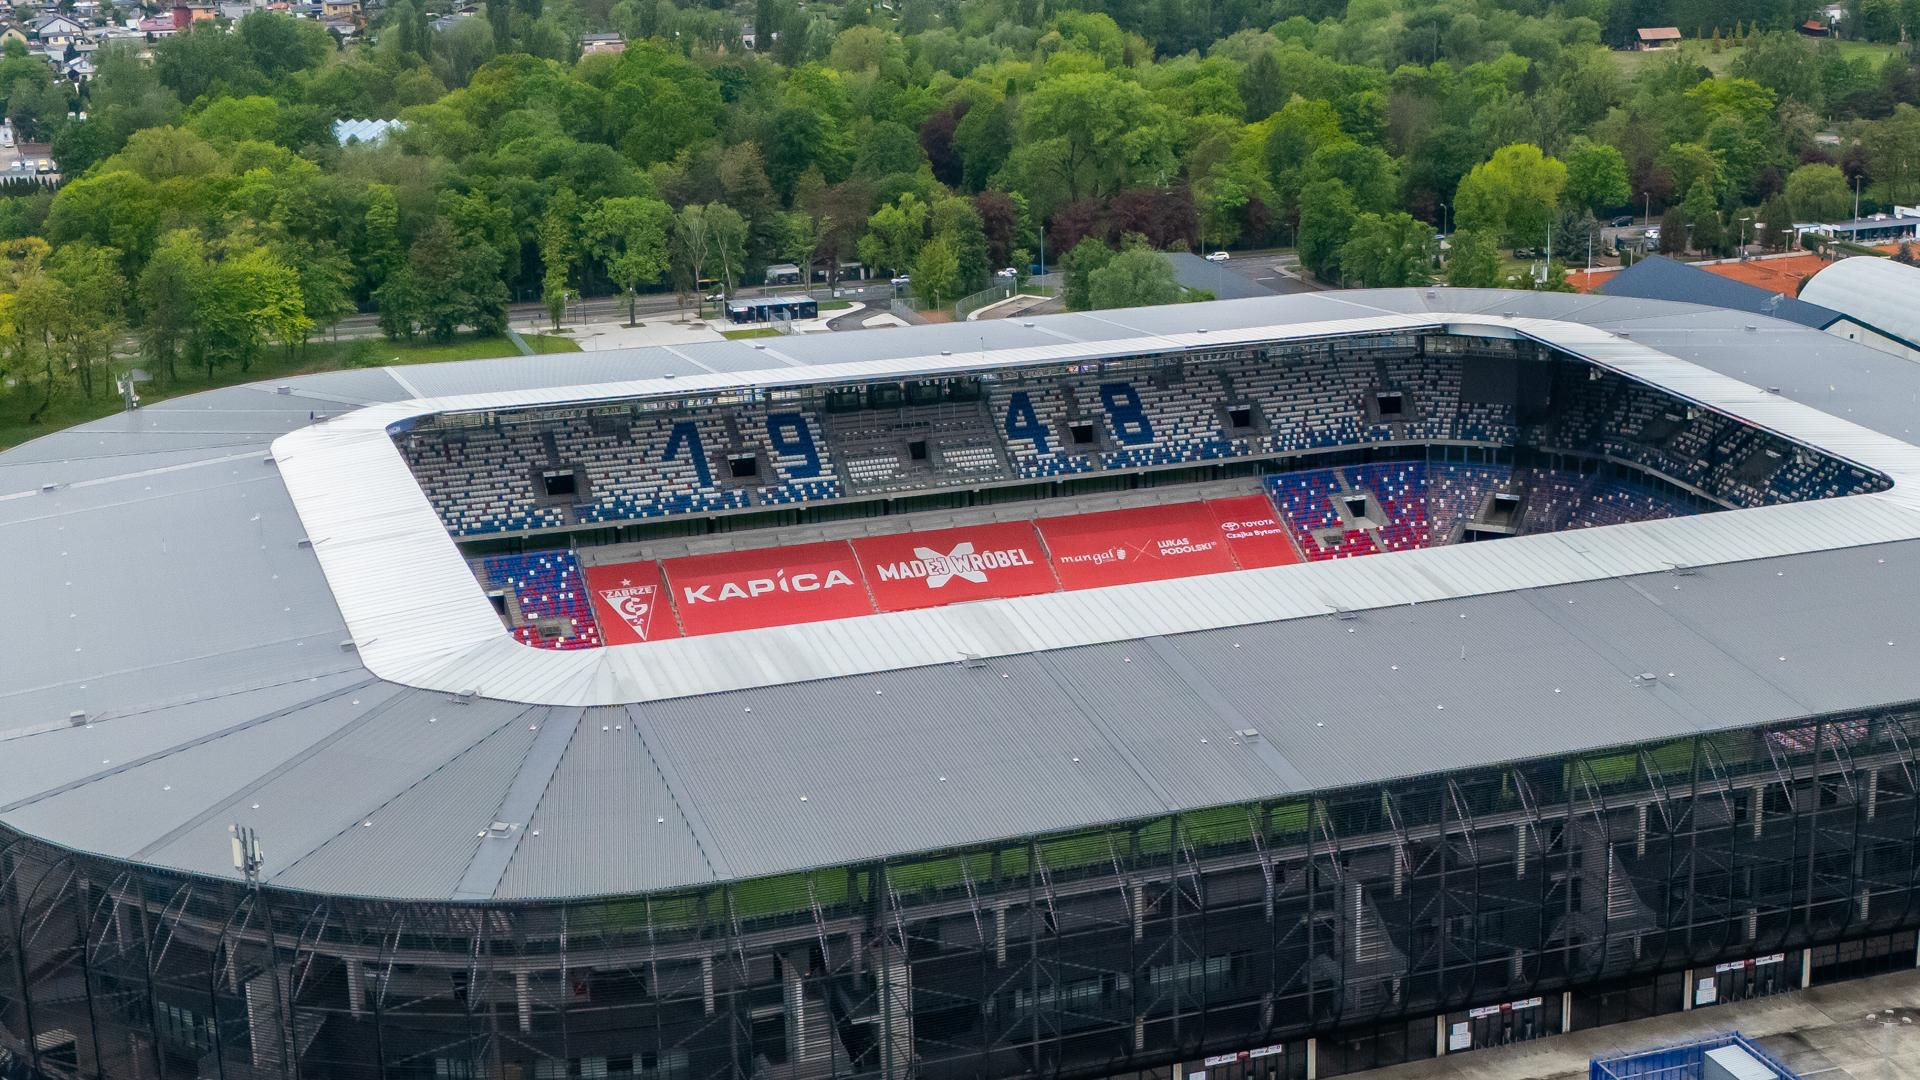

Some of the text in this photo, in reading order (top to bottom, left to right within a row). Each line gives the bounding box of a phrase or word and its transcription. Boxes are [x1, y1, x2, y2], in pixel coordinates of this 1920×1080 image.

[1240, 519, 1275, 528] TOYOTA
[1157, 537, 1190, 549] LUKAS
[1160, 542, 1213, 556] PODOLSKI
[876, 549, 1035, 582] MADEJ WRÓBEL
[607, 587, 653, 599] ZABRZE
